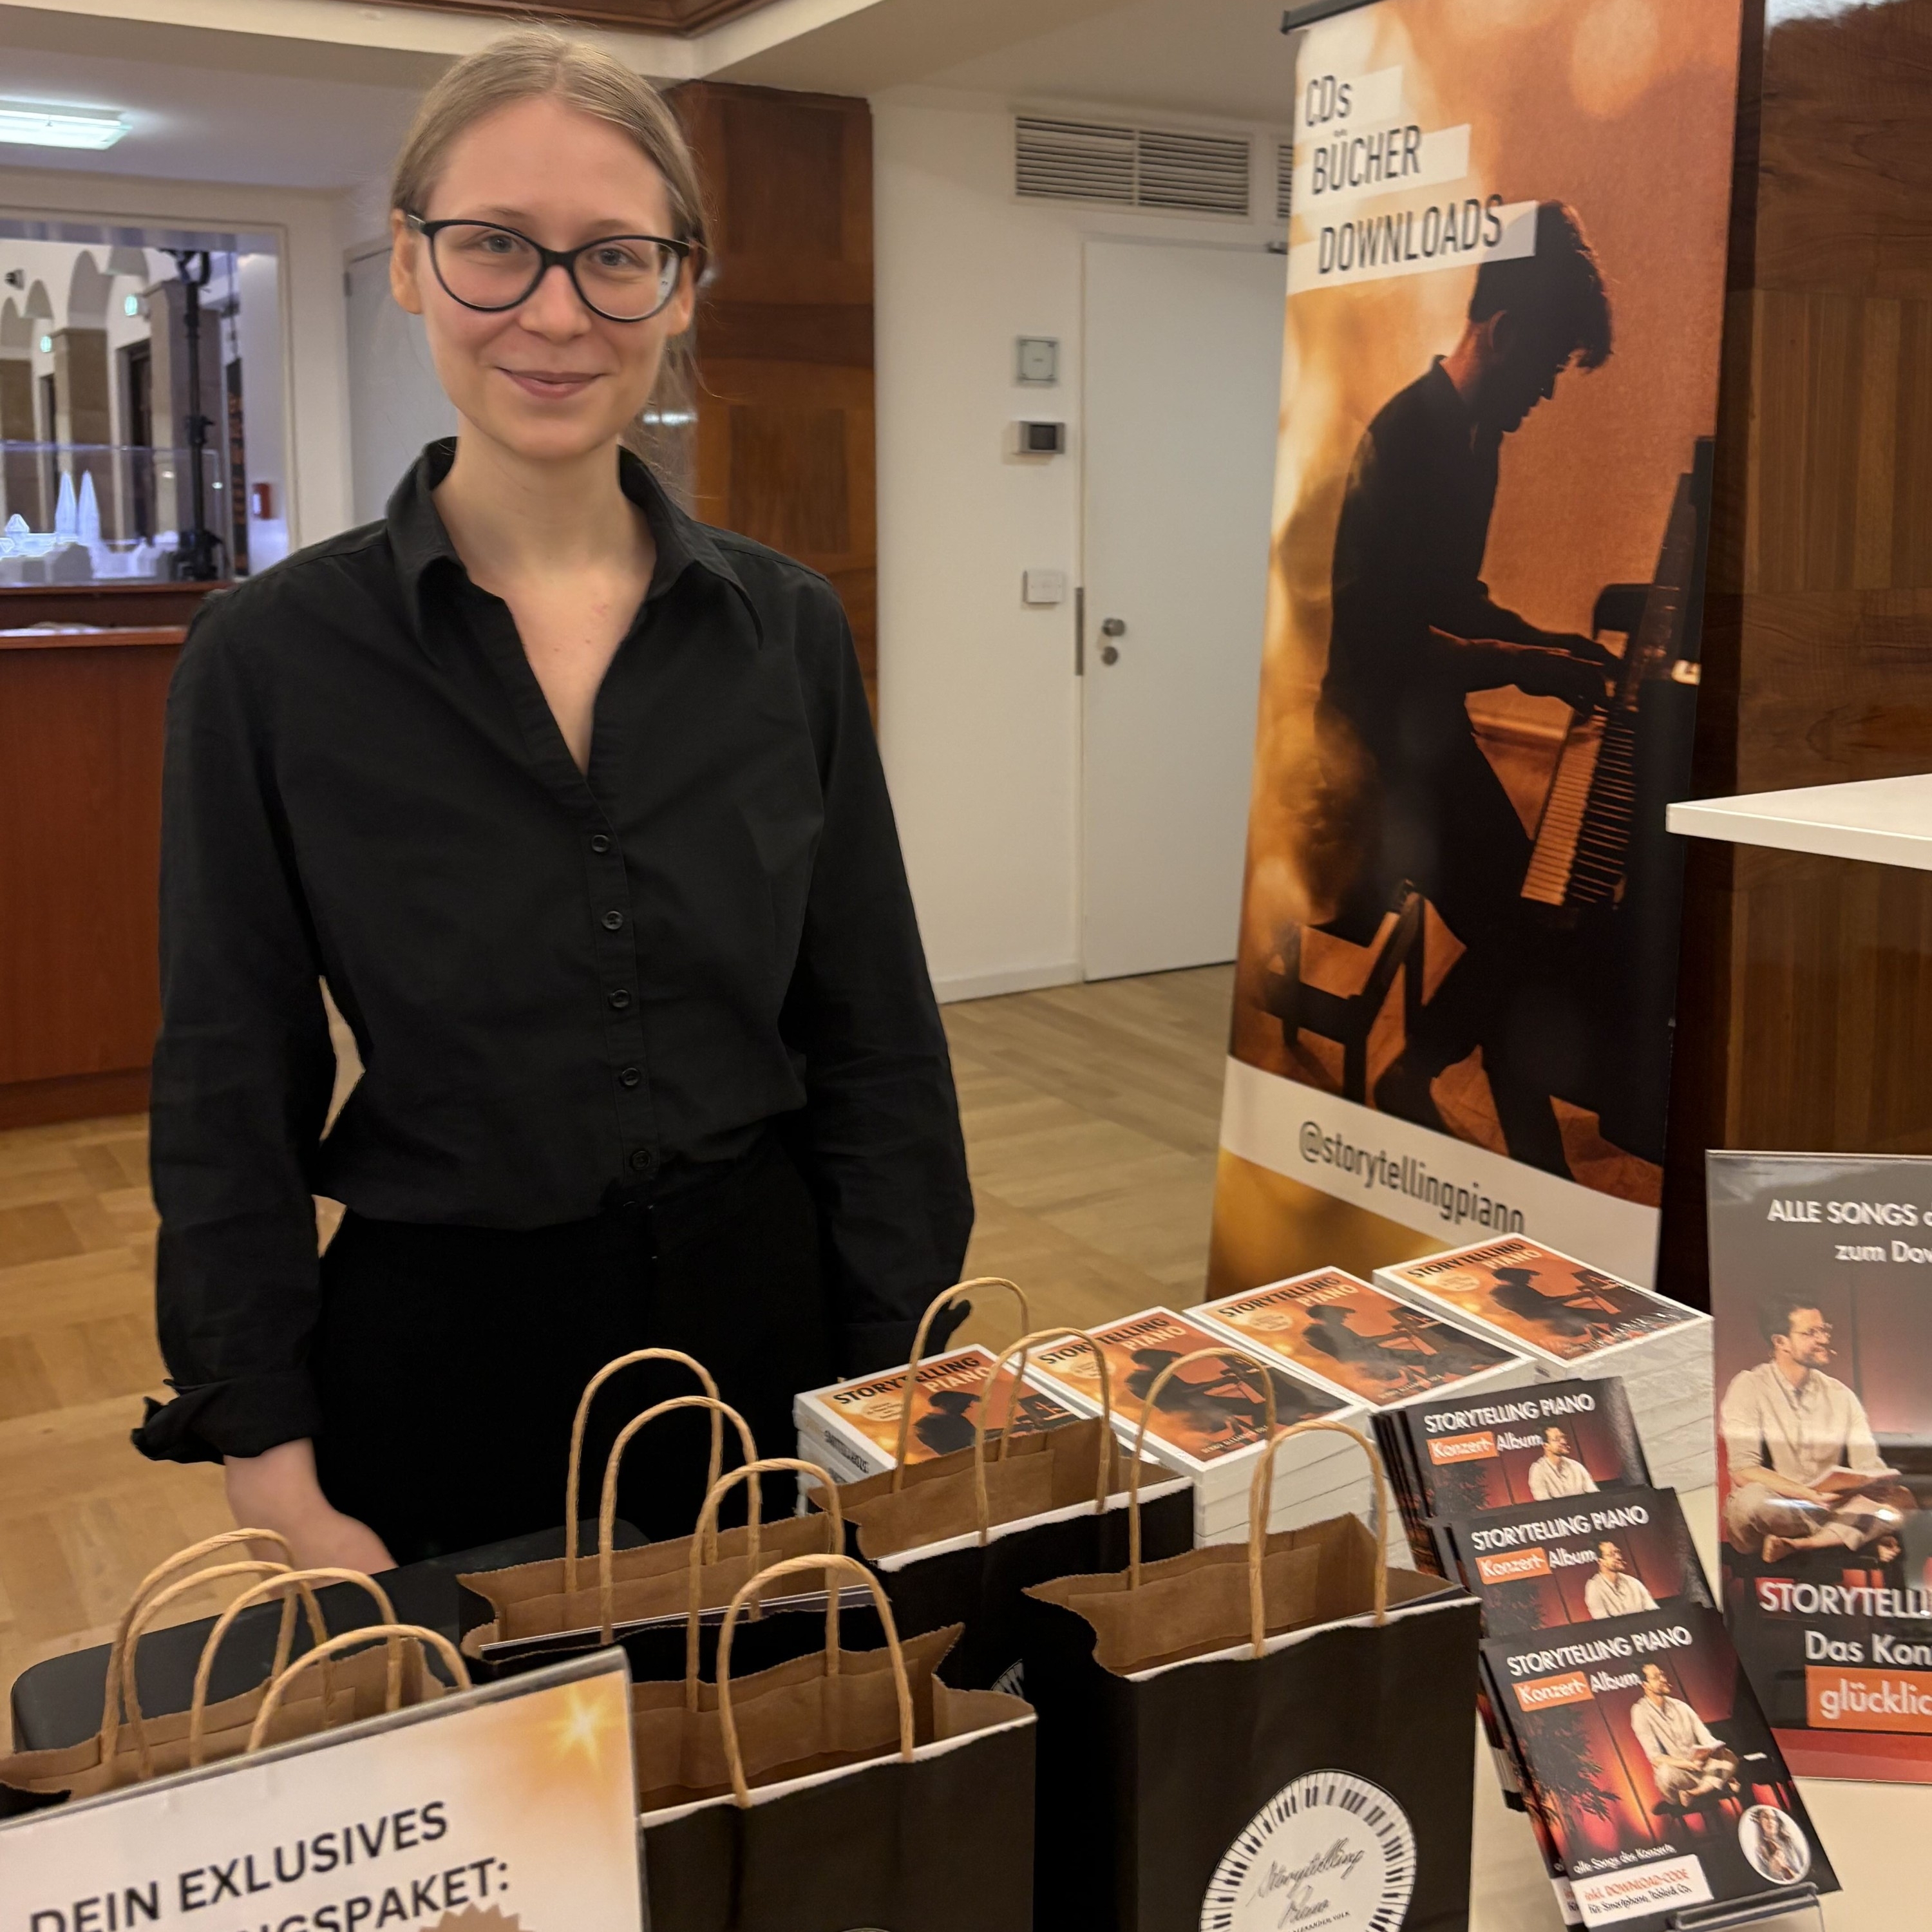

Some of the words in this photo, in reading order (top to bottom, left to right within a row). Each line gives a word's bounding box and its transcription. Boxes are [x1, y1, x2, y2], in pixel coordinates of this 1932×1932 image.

[1306, 75, 1352, 127] CDs
[1312, 125, 1422, 194] BÜCHER
[1318, 194, 1503, 274] DOWNLOADS
[1299, 1121, 1526, 1235] @storytellingpiano
[1767, 1199, 1823, 1223] ALLE
[1826, 1201, 1919, 1227] SONGS
[1408, 1242, 1526, 1278] STORYTELLING
[1481, 1249, 1542, 1269] PIANO
[1835, 1244, 1887, 1262] zum
[1218, 1276, 1341, 1318] STORYTELLING
[1296, 1284, 1359, 1307] PIANO
[1039, 1318, 1170, 1364] STORTELLING
[1121, 1325, 1187, 1350] PIANO
[1424, 1401, 1539, 1434] STORYTELLING
[1539, 1393, 1596, 1416] PIANO
[1497, 1432, 1544, 1452] Album
[1472, 1515, 1591, 1551] STORYTELLING
[1593, 1505, 1650, 1531] PIANO
[1548, 1548, 1598, 1569] Album
[1507, 1636, 1633, 1676] STORYTELLING
[1631, 1626, 1693, 1653] PIANO
[1804, 1630, 1865, 1663] Das
[1589, 1671, 1643, 1693] Album
[30, 1882, 160, 1932] DEIN
[178, 1801, 448, 1913] EXLUSIVES
[240, 1857, 509, 1932] SPAKET:
